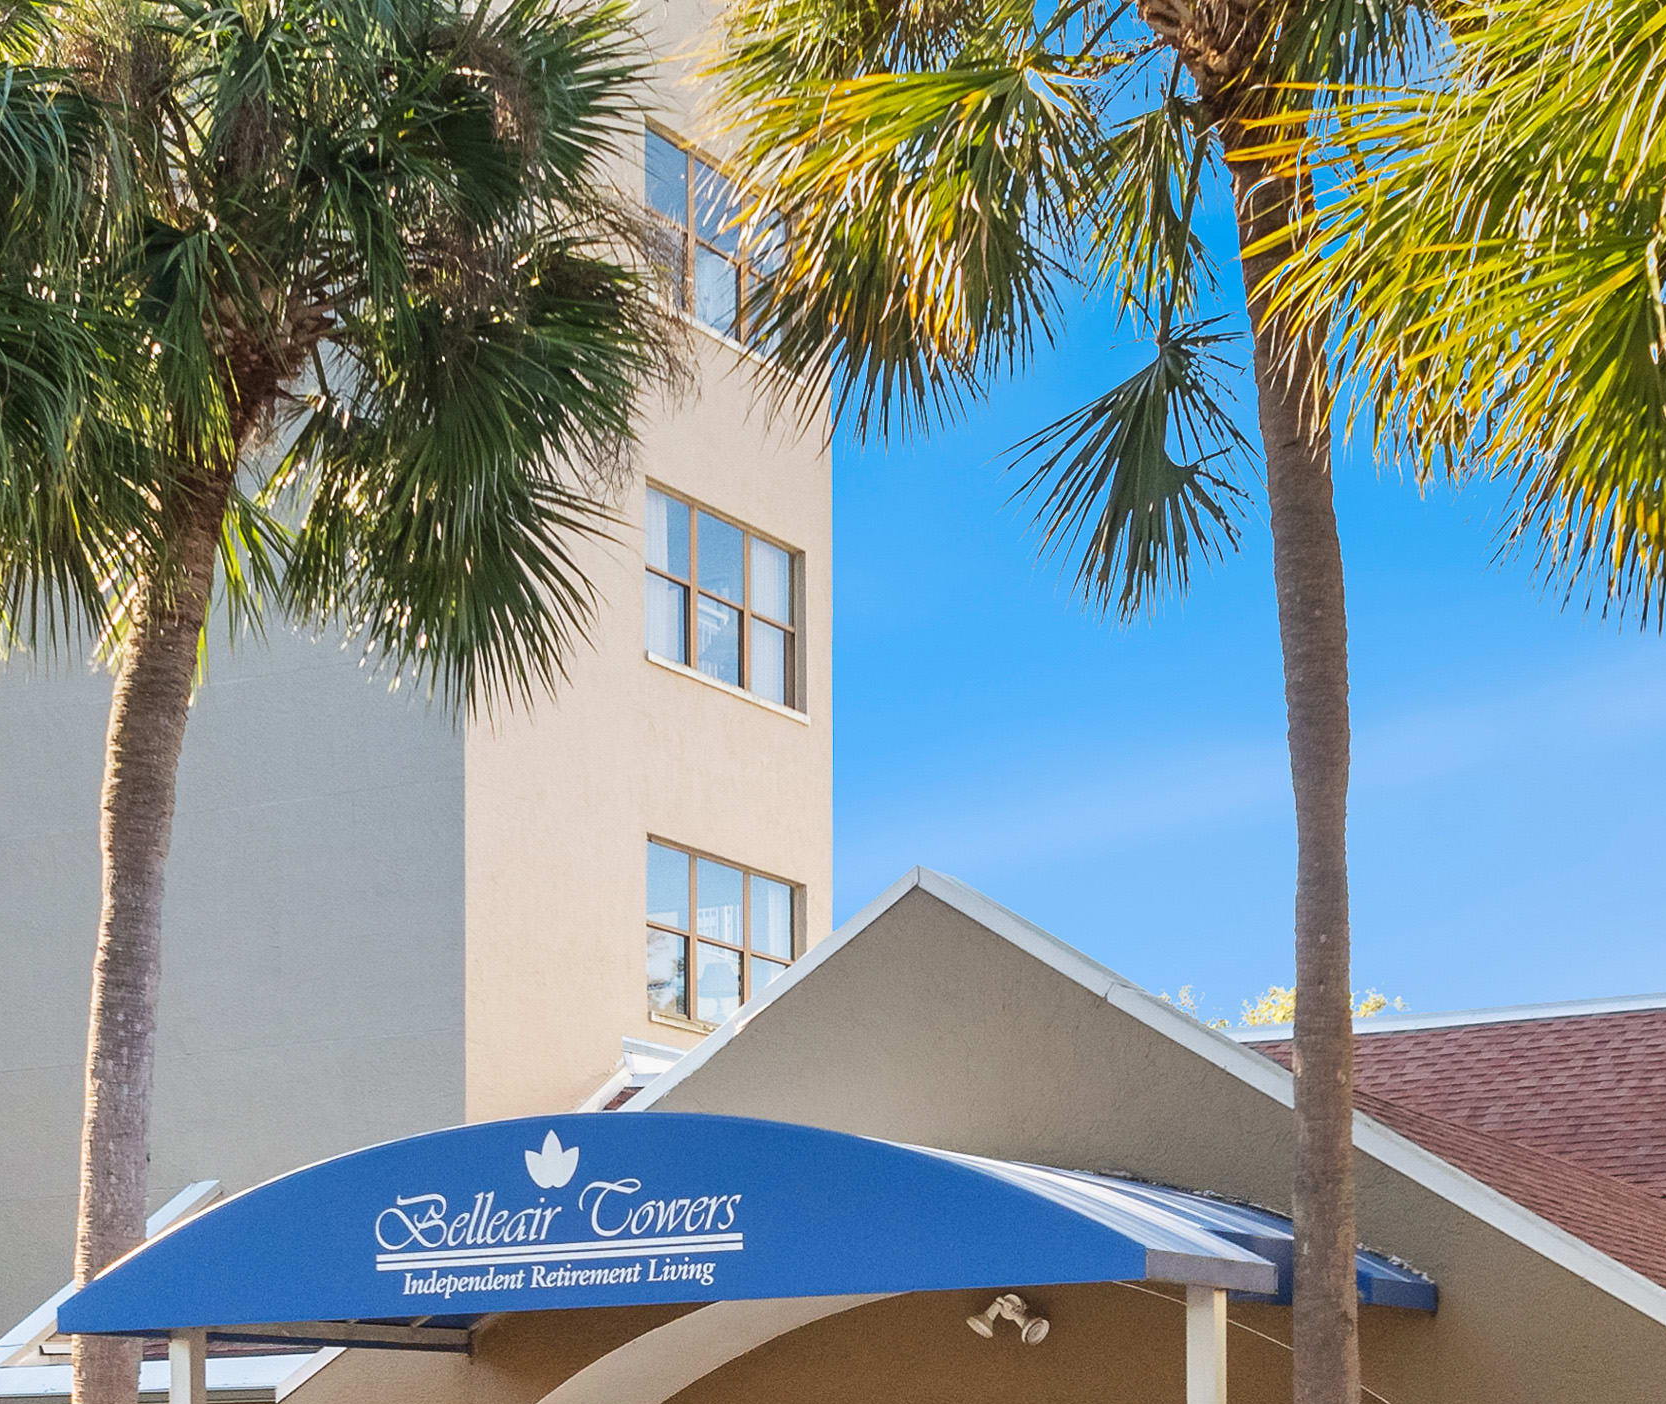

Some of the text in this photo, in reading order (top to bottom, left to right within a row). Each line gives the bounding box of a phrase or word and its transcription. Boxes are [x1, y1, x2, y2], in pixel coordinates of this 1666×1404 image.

[375, 1178, 742, 1250] Belleair Towers
[403, 1256, 716, 1299] Independent Retirement Living
